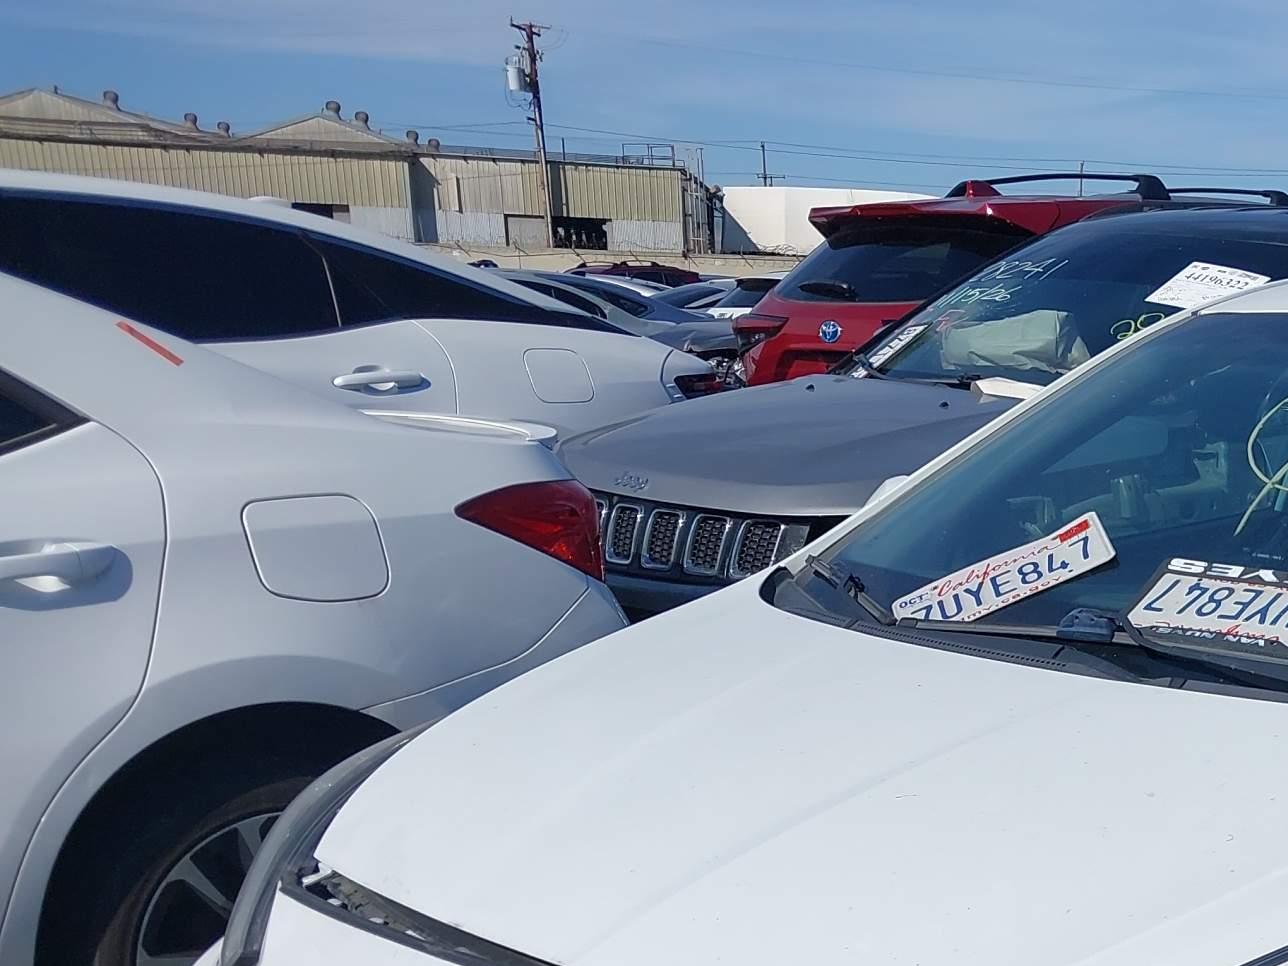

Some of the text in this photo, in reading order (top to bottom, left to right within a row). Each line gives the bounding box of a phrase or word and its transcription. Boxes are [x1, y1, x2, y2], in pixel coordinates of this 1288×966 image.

[614, 471, 649, 493] Jeep
[899, 545, 1056, 609] OCT California
[910, 535, 1090, 621] 7UYE847
